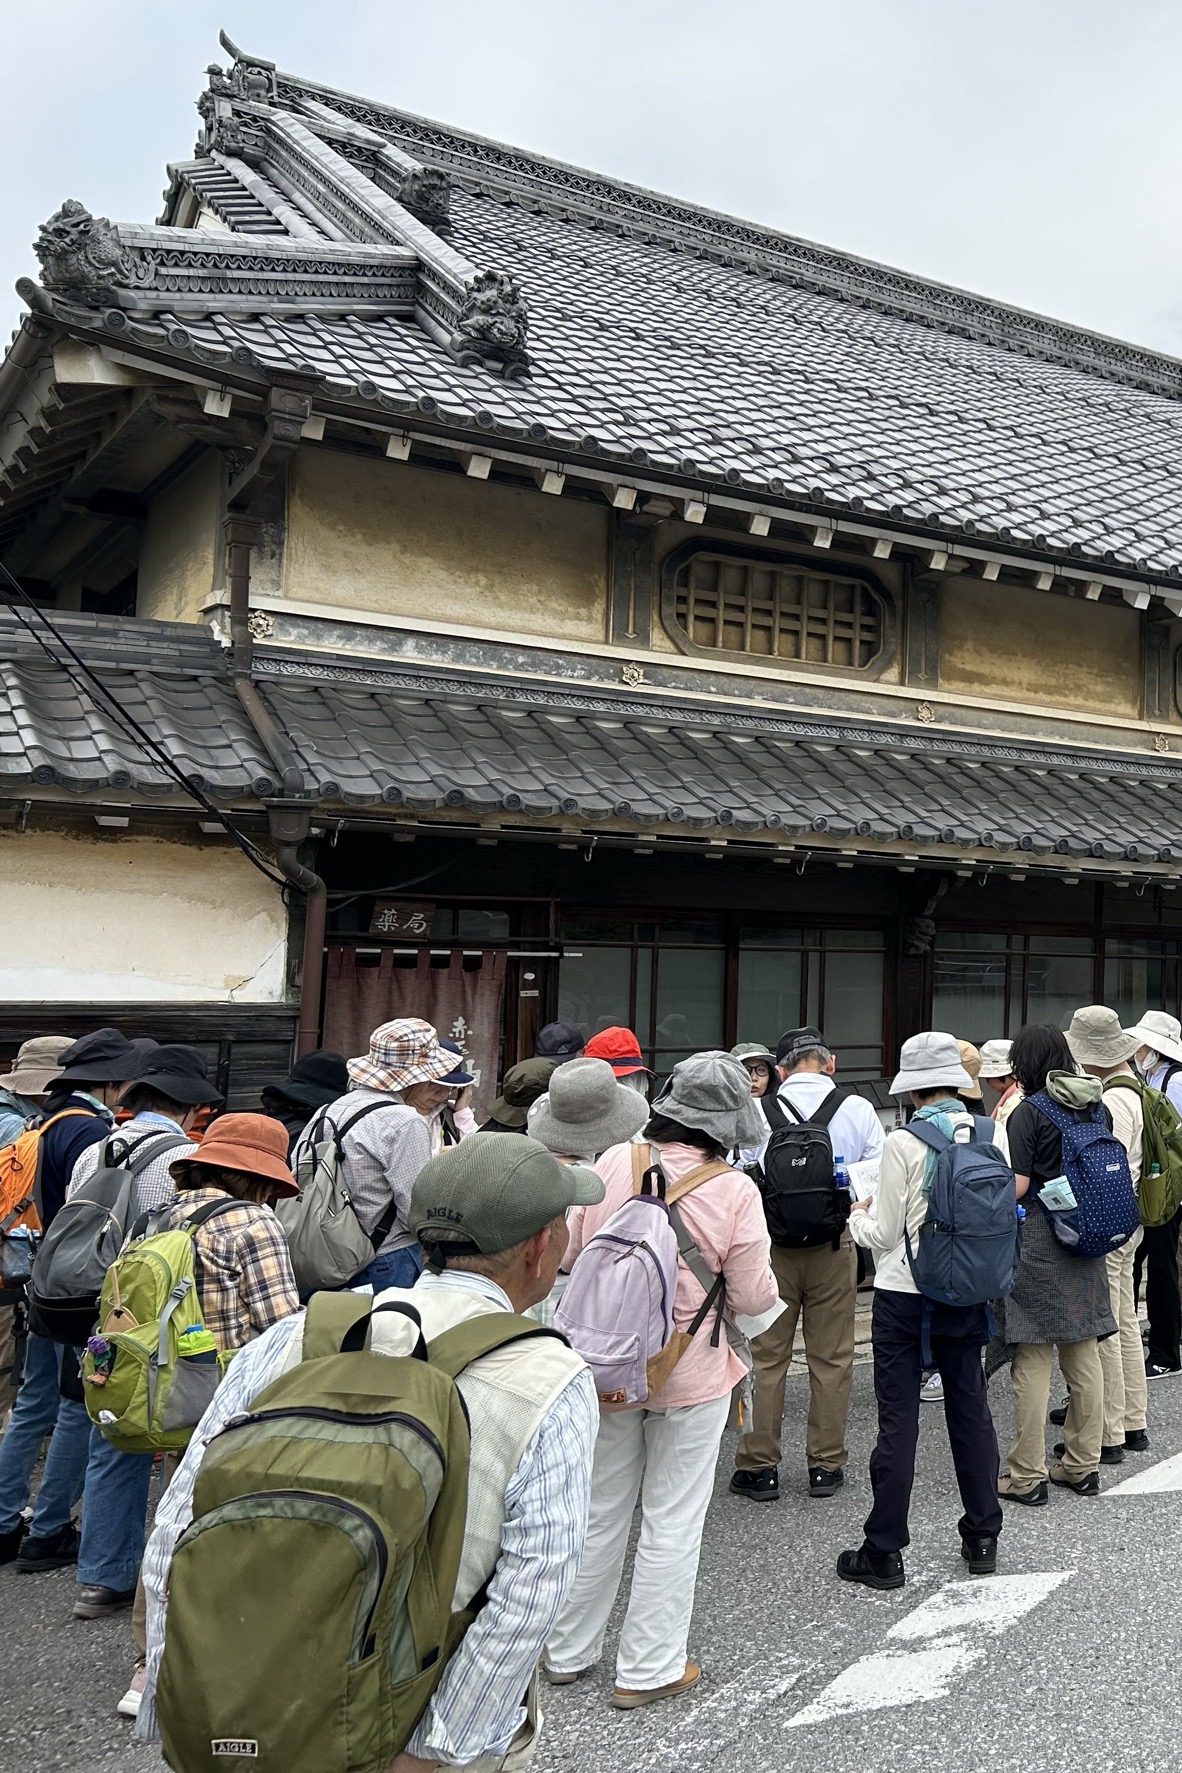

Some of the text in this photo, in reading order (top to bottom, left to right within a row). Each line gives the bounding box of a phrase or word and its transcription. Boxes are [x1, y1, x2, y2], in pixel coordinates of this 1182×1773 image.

[375, 908, 427, 934] 薬局
[426, 1206, 464, 1223] AIGLE
[218, 1742, 253, 1753] AIGLE
